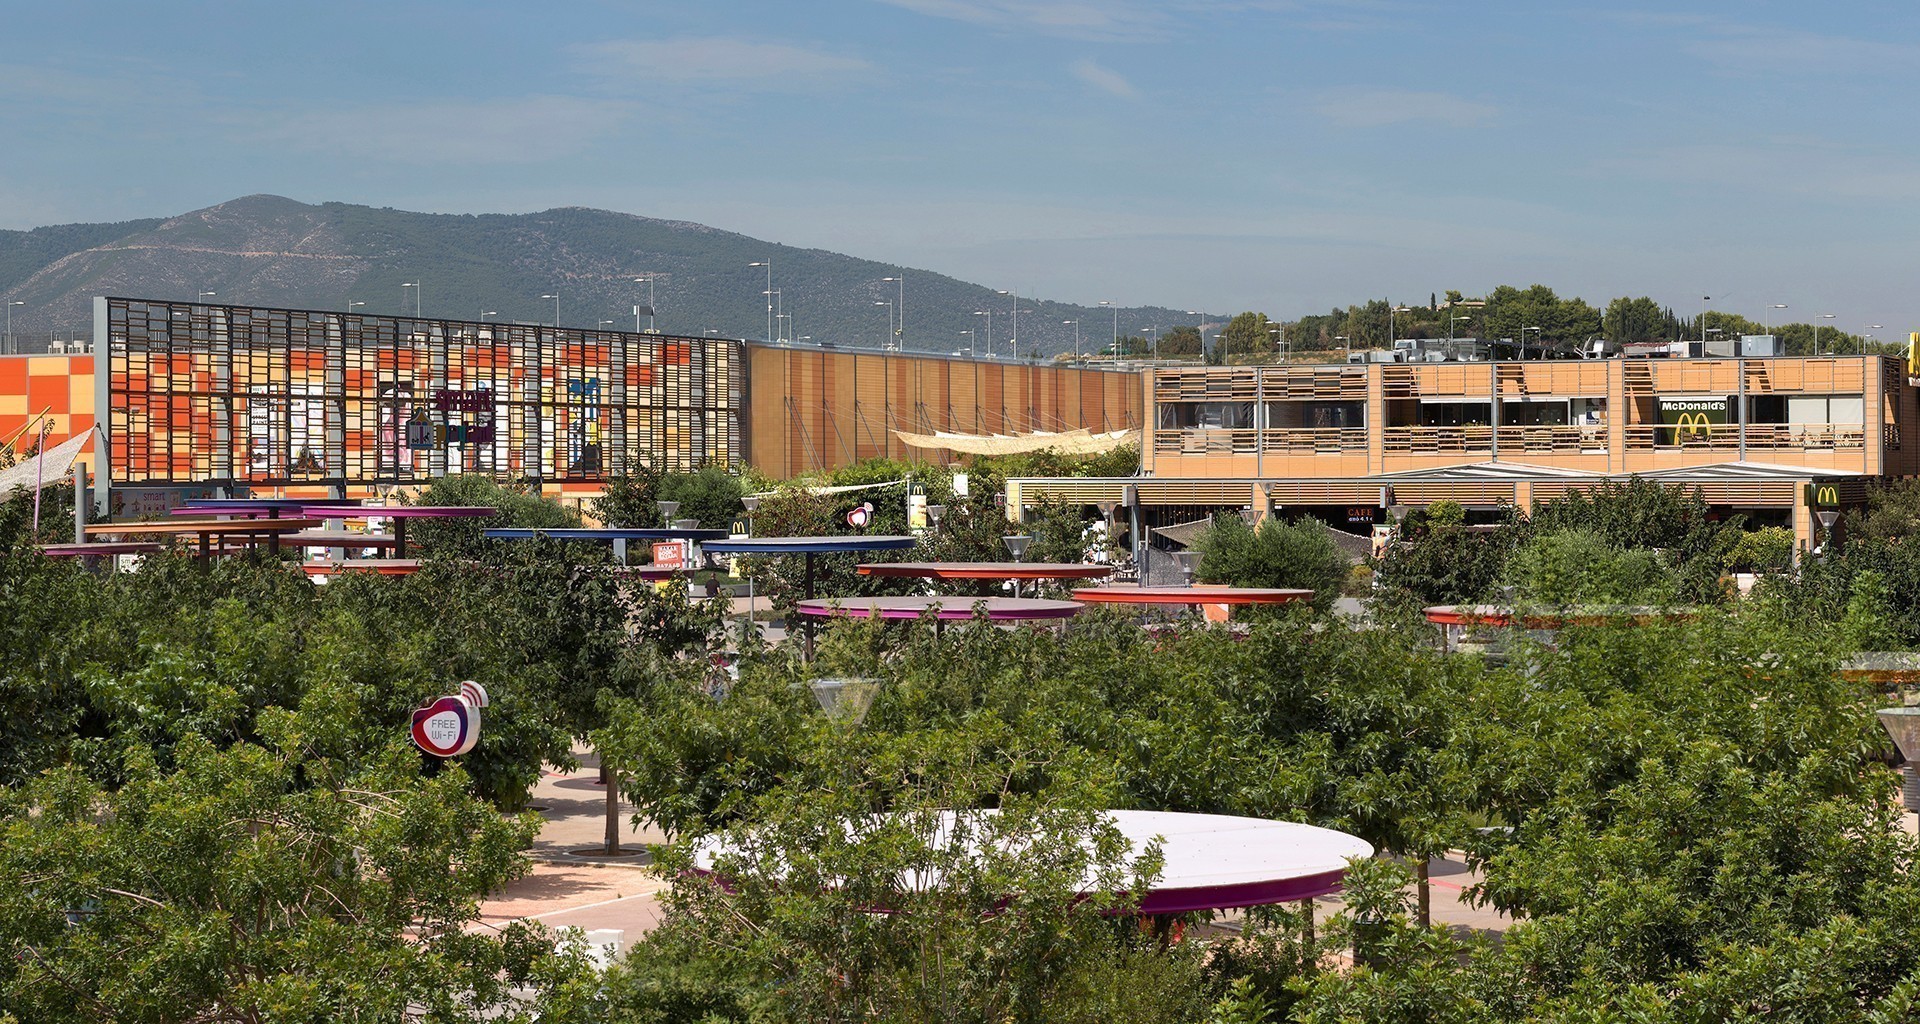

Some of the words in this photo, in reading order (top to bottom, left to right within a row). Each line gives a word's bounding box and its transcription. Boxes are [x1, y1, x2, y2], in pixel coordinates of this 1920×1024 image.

[436, 388, 493, 411] smart
[1661, 402, 1725, 411] McDonald's
[143, 492, 166, 501] smart
[1347, 508, 1373, 516] CAFE
[431, 719, 456, 729] FREE
[431, 730, 456, 740] Wi-Fi
